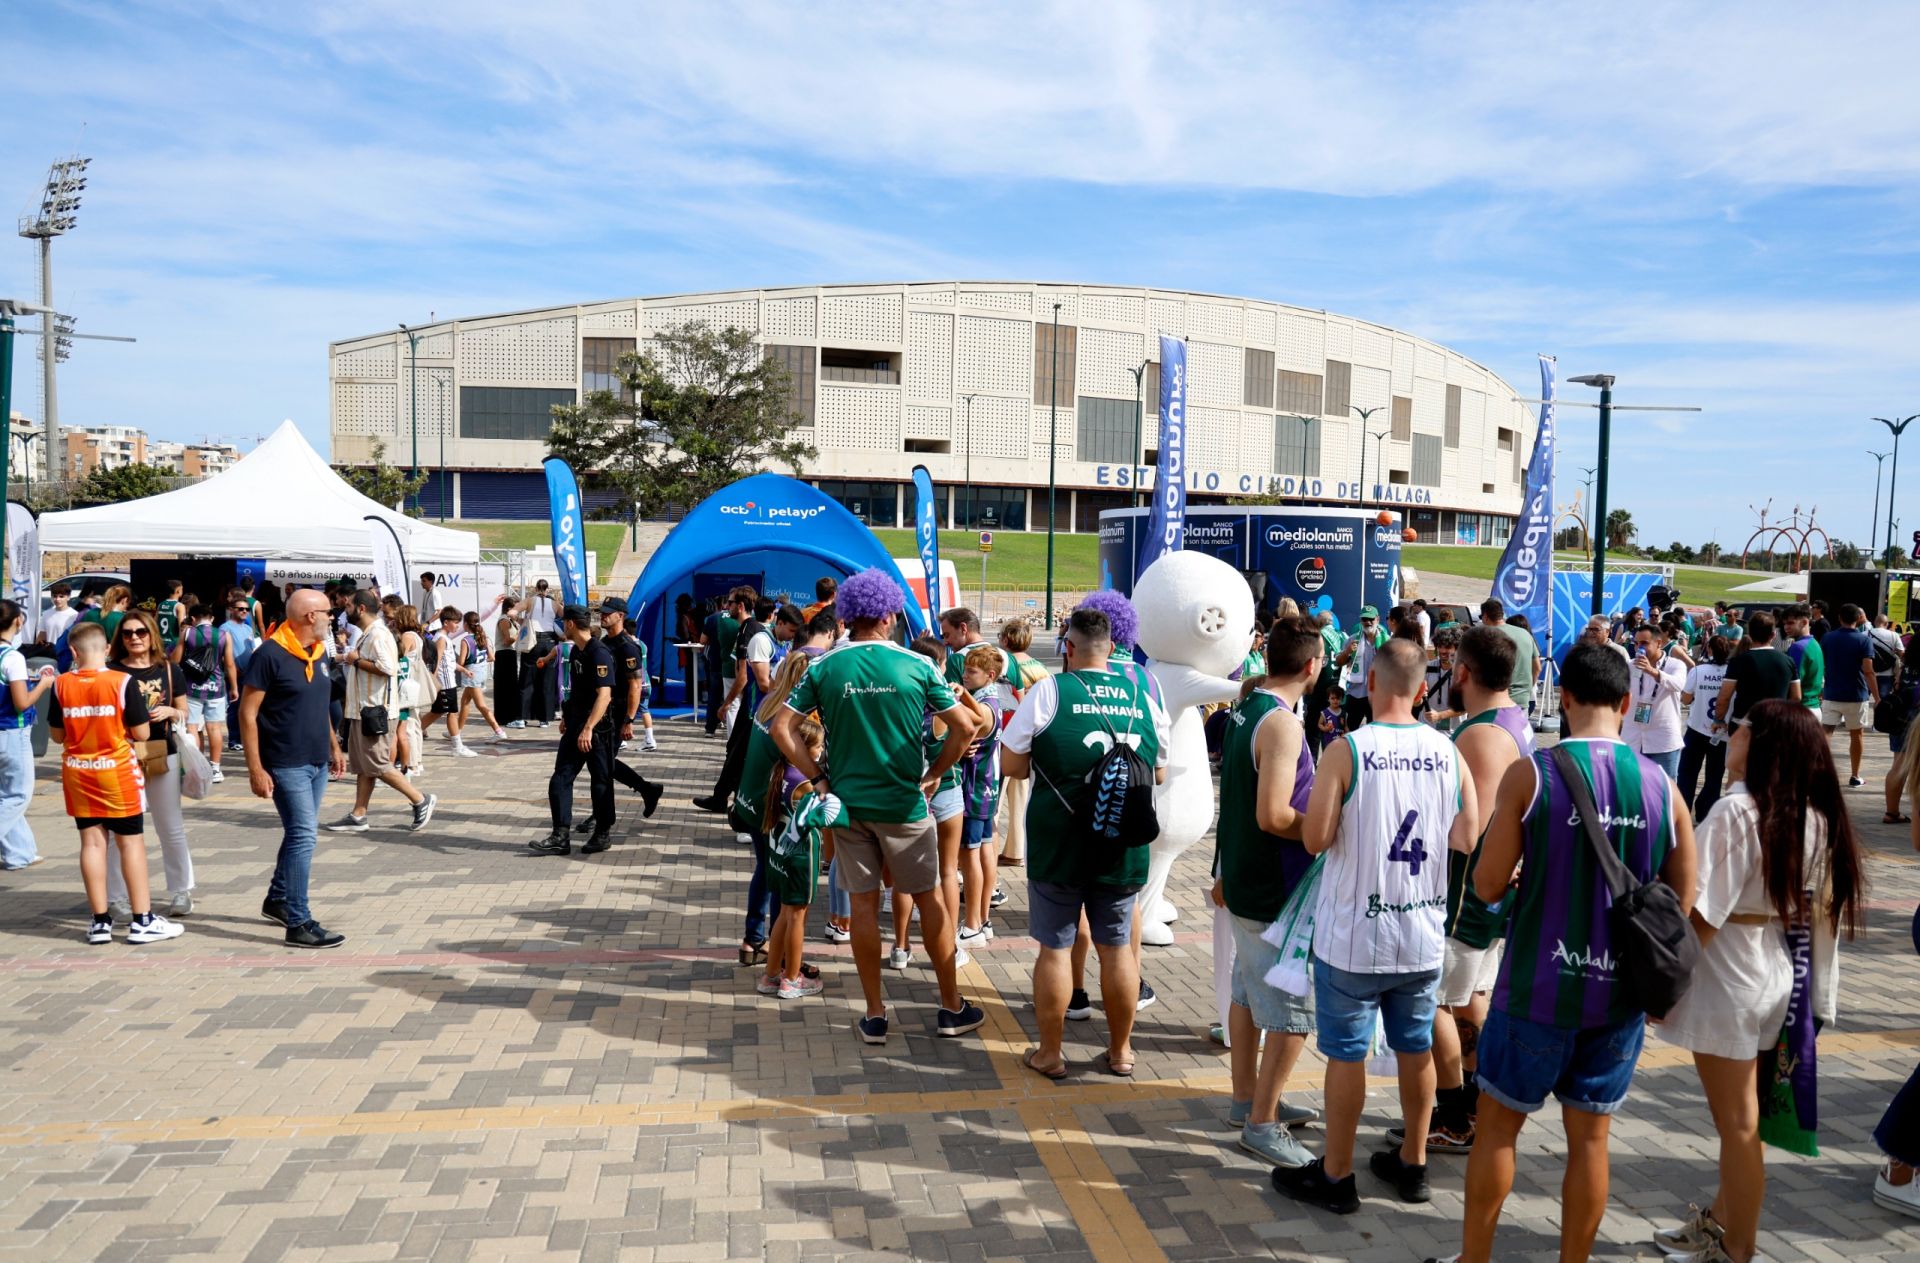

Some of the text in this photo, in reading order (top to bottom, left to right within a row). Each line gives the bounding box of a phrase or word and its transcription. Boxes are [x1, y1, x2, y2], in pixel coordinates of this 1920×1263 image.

[1097, 466, 1220, 491] ESTIO
[1338, 482, 1359, 499] DE
[720, 503, 818, 519] acb pelayo
[1183, 523, 1234, 538] olanum
[1269, 527, 1354, 543] mediolanum
[1290, 542, 1314, 551] ¿Cuáles
[273, 569, 285, 578] 30
[288, 570, 312, 579] años
[435, 573, 460, 588] AX
[1579, 591, 1614, 599] ensa
[160, 618, 169, 634] 9
[1086, 684, 1130, 701] LEIVA
[1362, 750, 1449, 773] Kalinoski
[1387, 809, 1428, 877] 4
